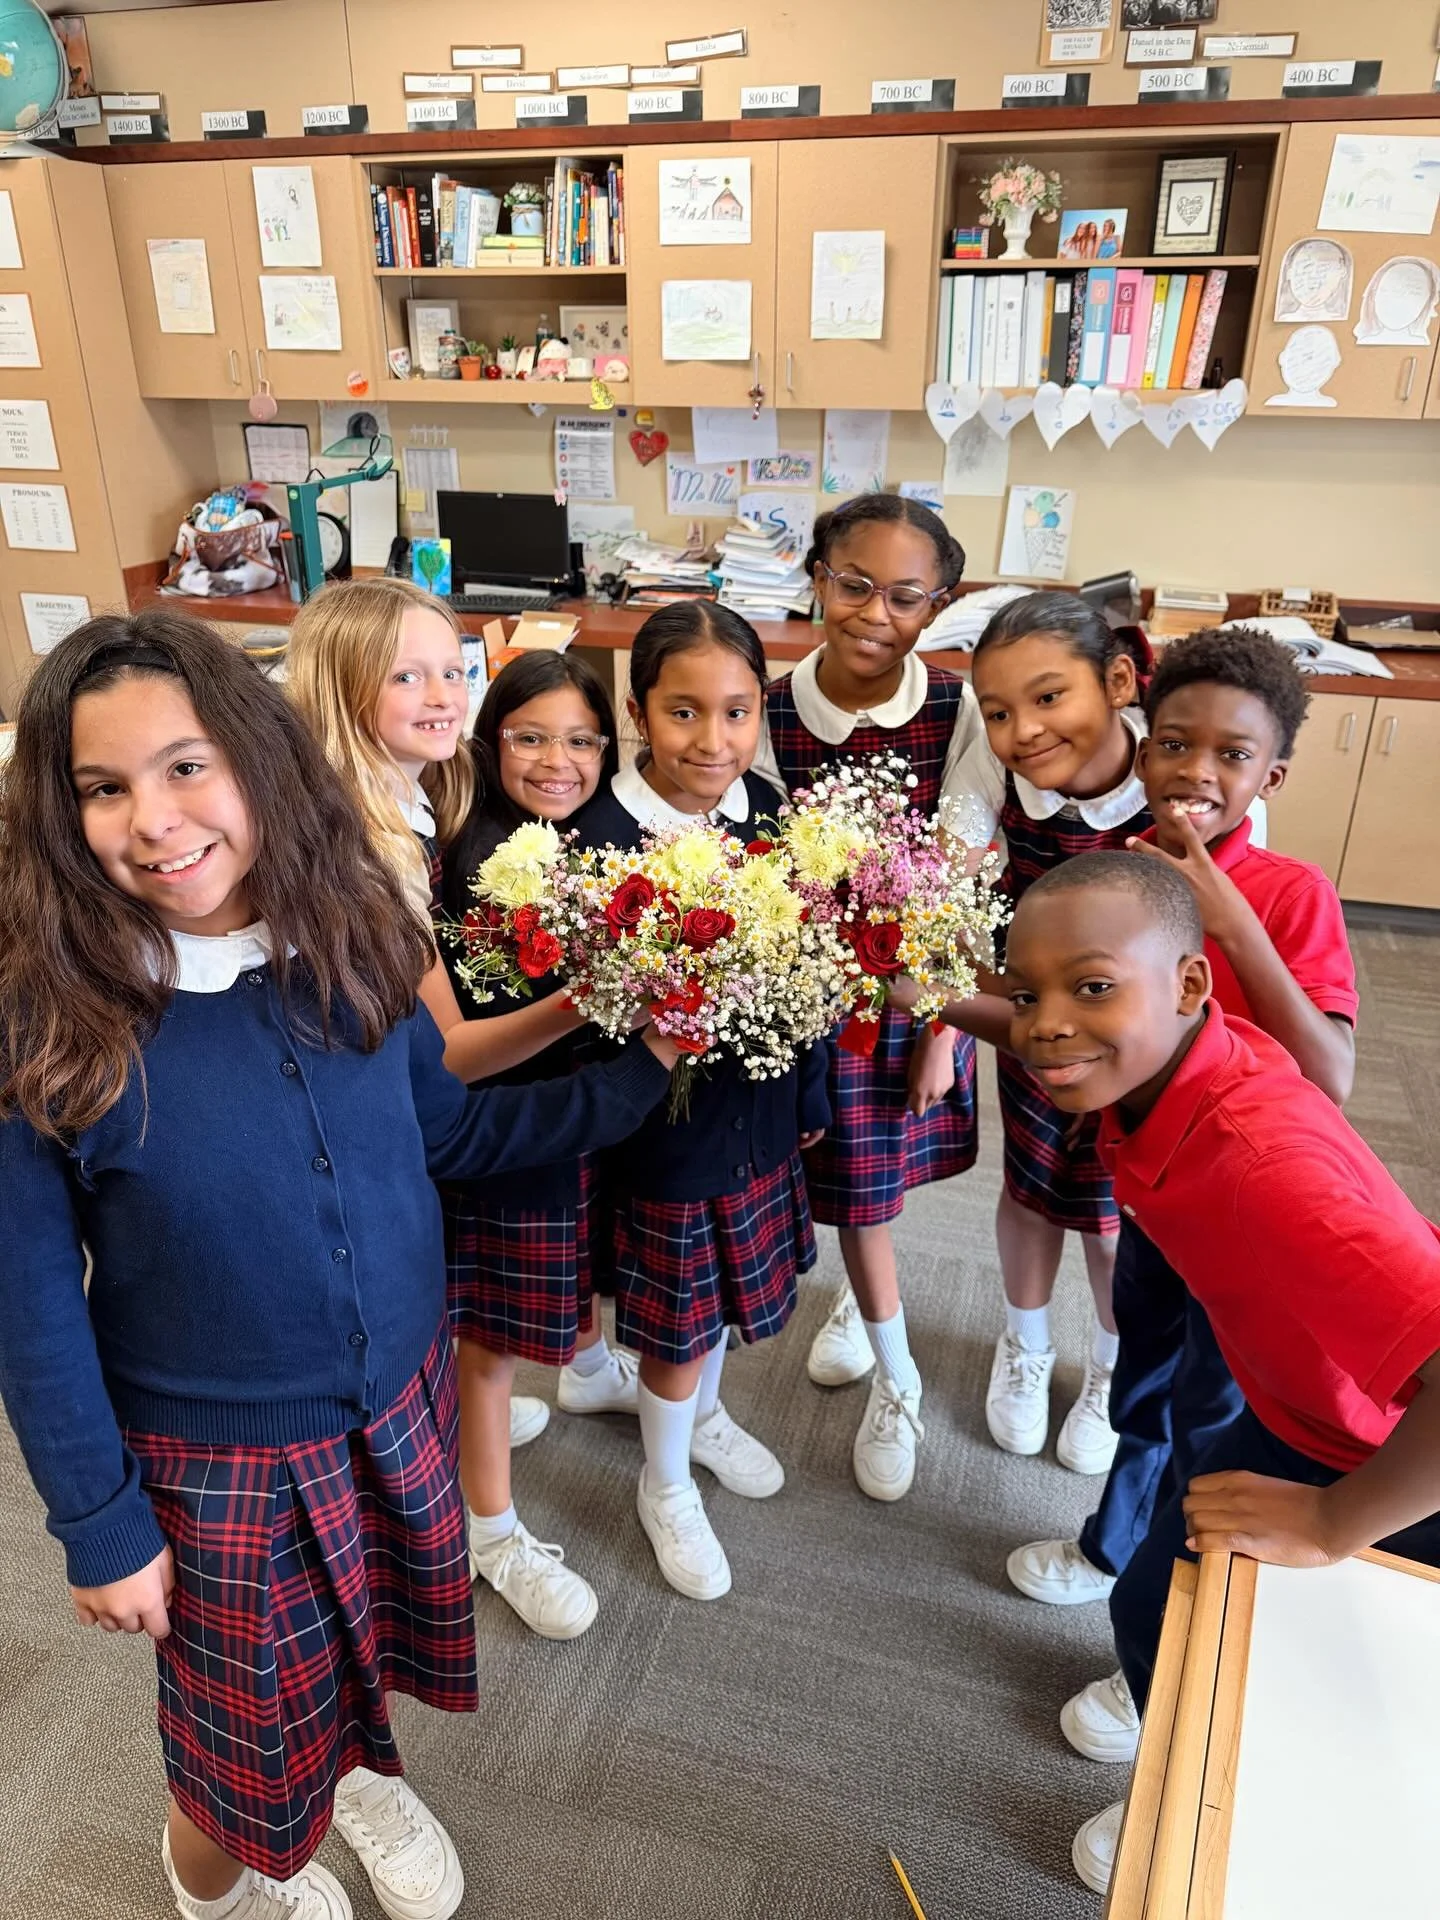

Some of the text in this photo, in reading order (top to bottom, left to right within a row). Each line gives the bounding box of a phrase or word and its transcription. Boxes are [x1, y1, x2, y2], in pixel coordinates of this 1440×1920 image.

[1165, 37, 1175, 46] the
[1147, 73, 1195, 88] 500 BC
[1289, 68, 1340, 83] 400 BC
[880, 85, 923, 100] 700 BC
[1010, 79, 1055, 94] 600 BC
[634, 96, 673, 110] 900 BC
[748, 90, 789, 105] 800 BC
[412, 104, 453, 119] 1100 BC
[523, 101, 564, 115] 1000 BC
[208, 116, 246, 129] 1300 BC
[305, 110, 344, 124] 1200 BC
[113, 119, 149, 132] 1400 BC
